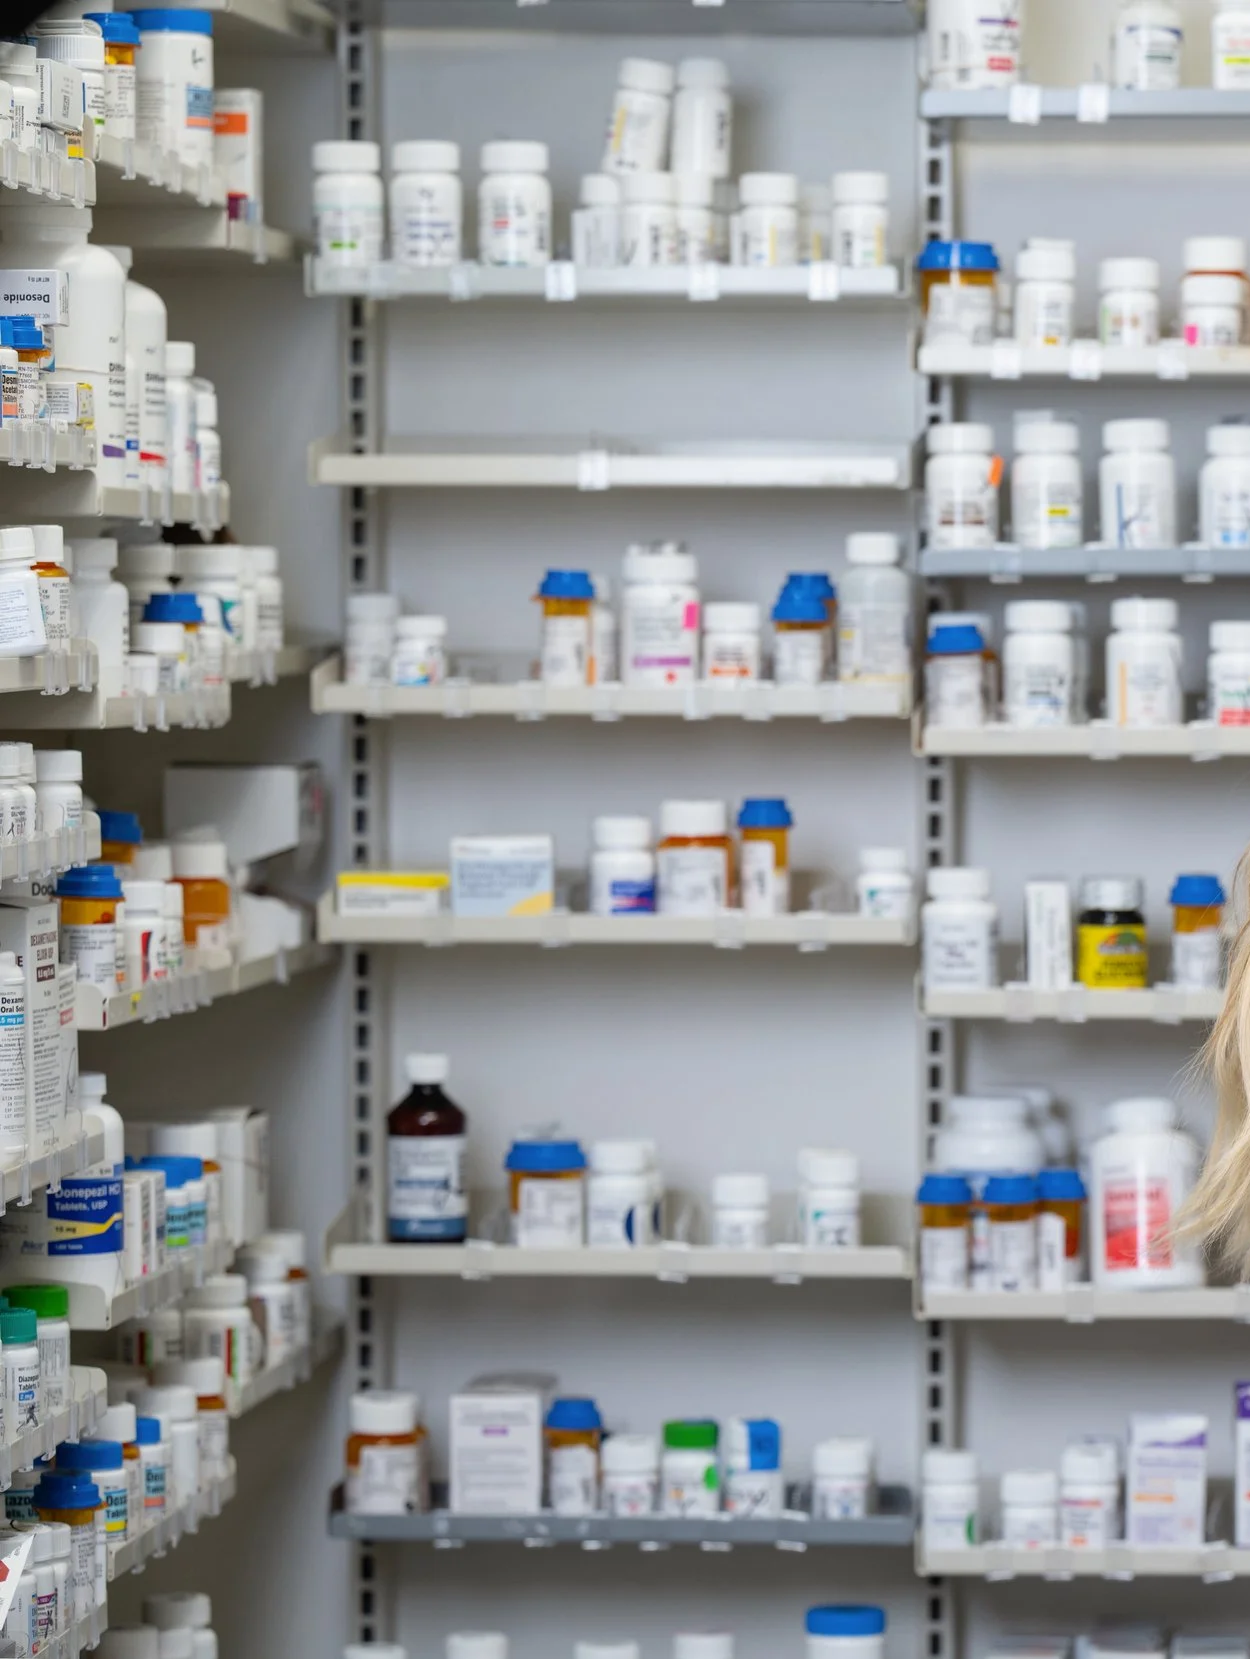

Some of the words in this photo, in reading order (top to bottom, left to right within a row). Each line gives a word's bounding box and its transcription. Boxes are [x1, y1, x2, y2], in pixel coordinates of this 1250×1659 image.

[4, 293, 50, 303] Desonide
[1, 1006, 14, 1014] Oral
[55, 1183, 108, 1199] Donepezil
[91, 1201, 108, 1210] USP
